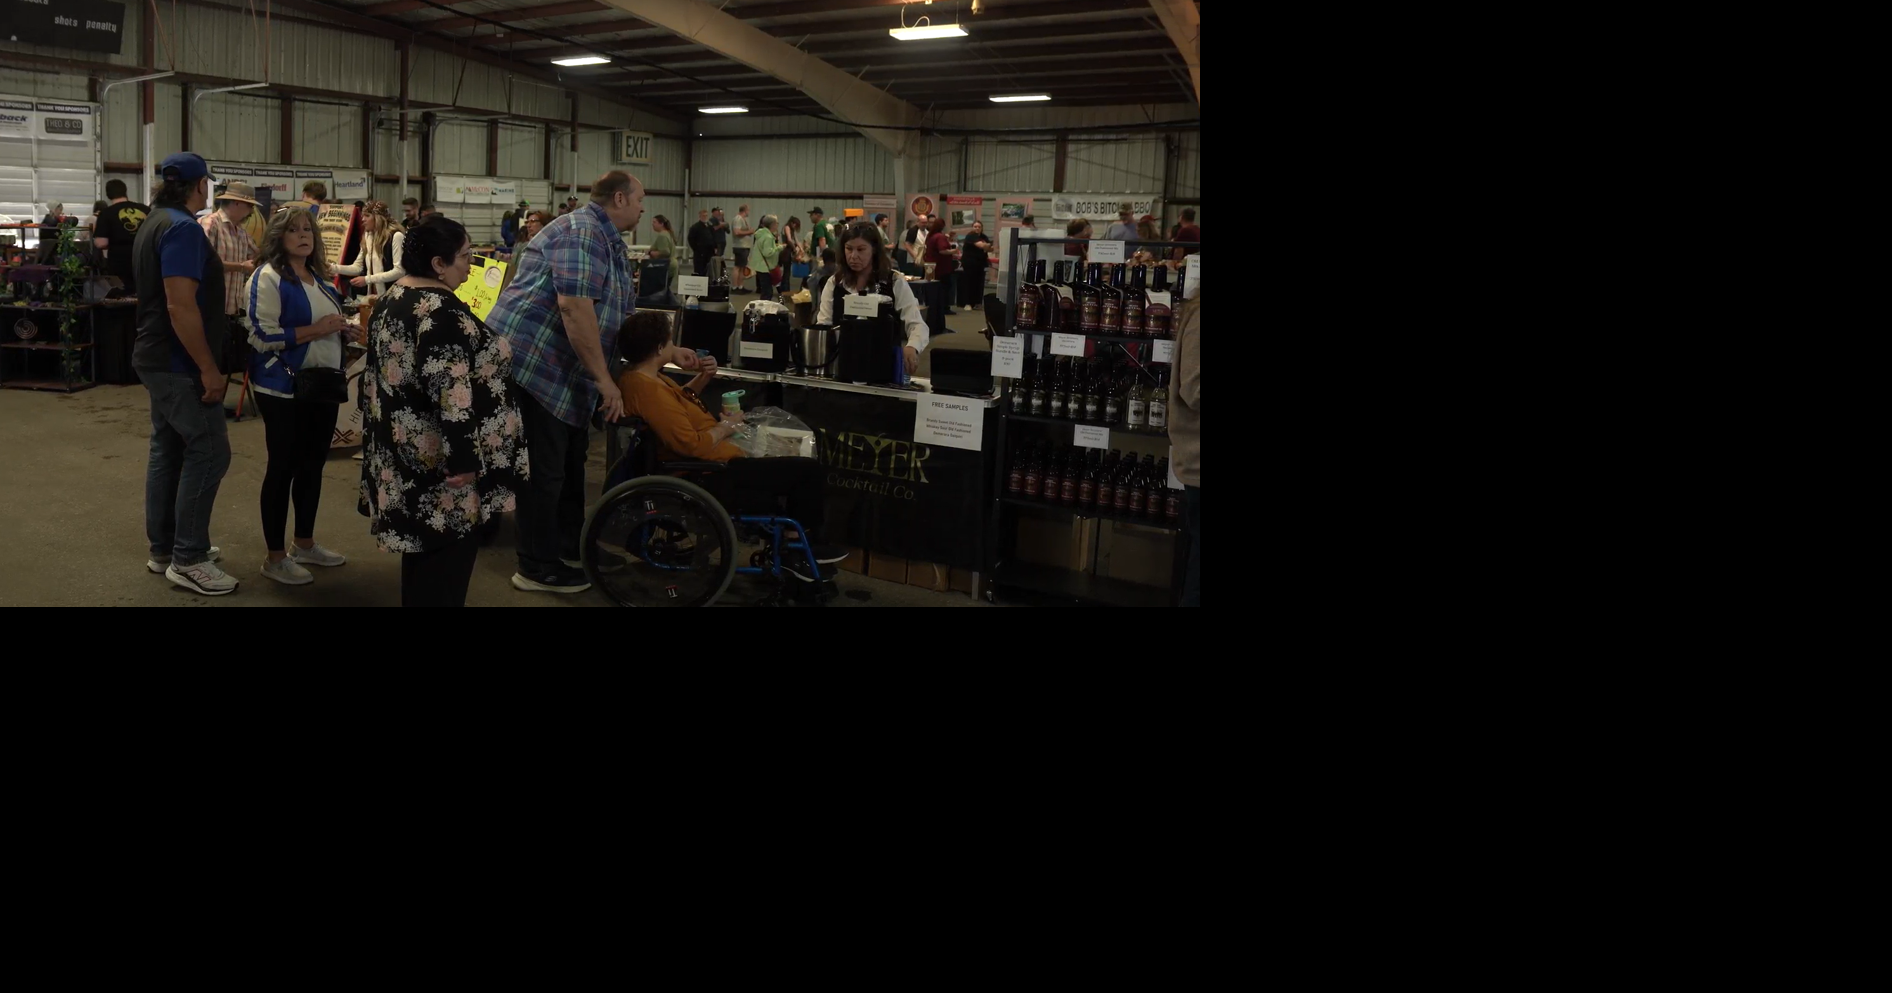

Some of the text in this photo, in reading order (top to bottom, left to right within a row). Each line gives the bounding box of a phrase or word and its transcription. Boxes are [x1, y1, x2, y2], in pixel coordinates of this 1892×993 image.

[54, 15, 117, 33] shots penalty
[46, 120, 62, 128] THEO
[626, 136, 650, 158] EXIT
[261, 183, 287, 191] Fdorff
[1076, 202, 1099, 214] BOB'S
[819, 428, 931, 484] MEYER
[826, 472, 916, 500] Cocktail Co.
